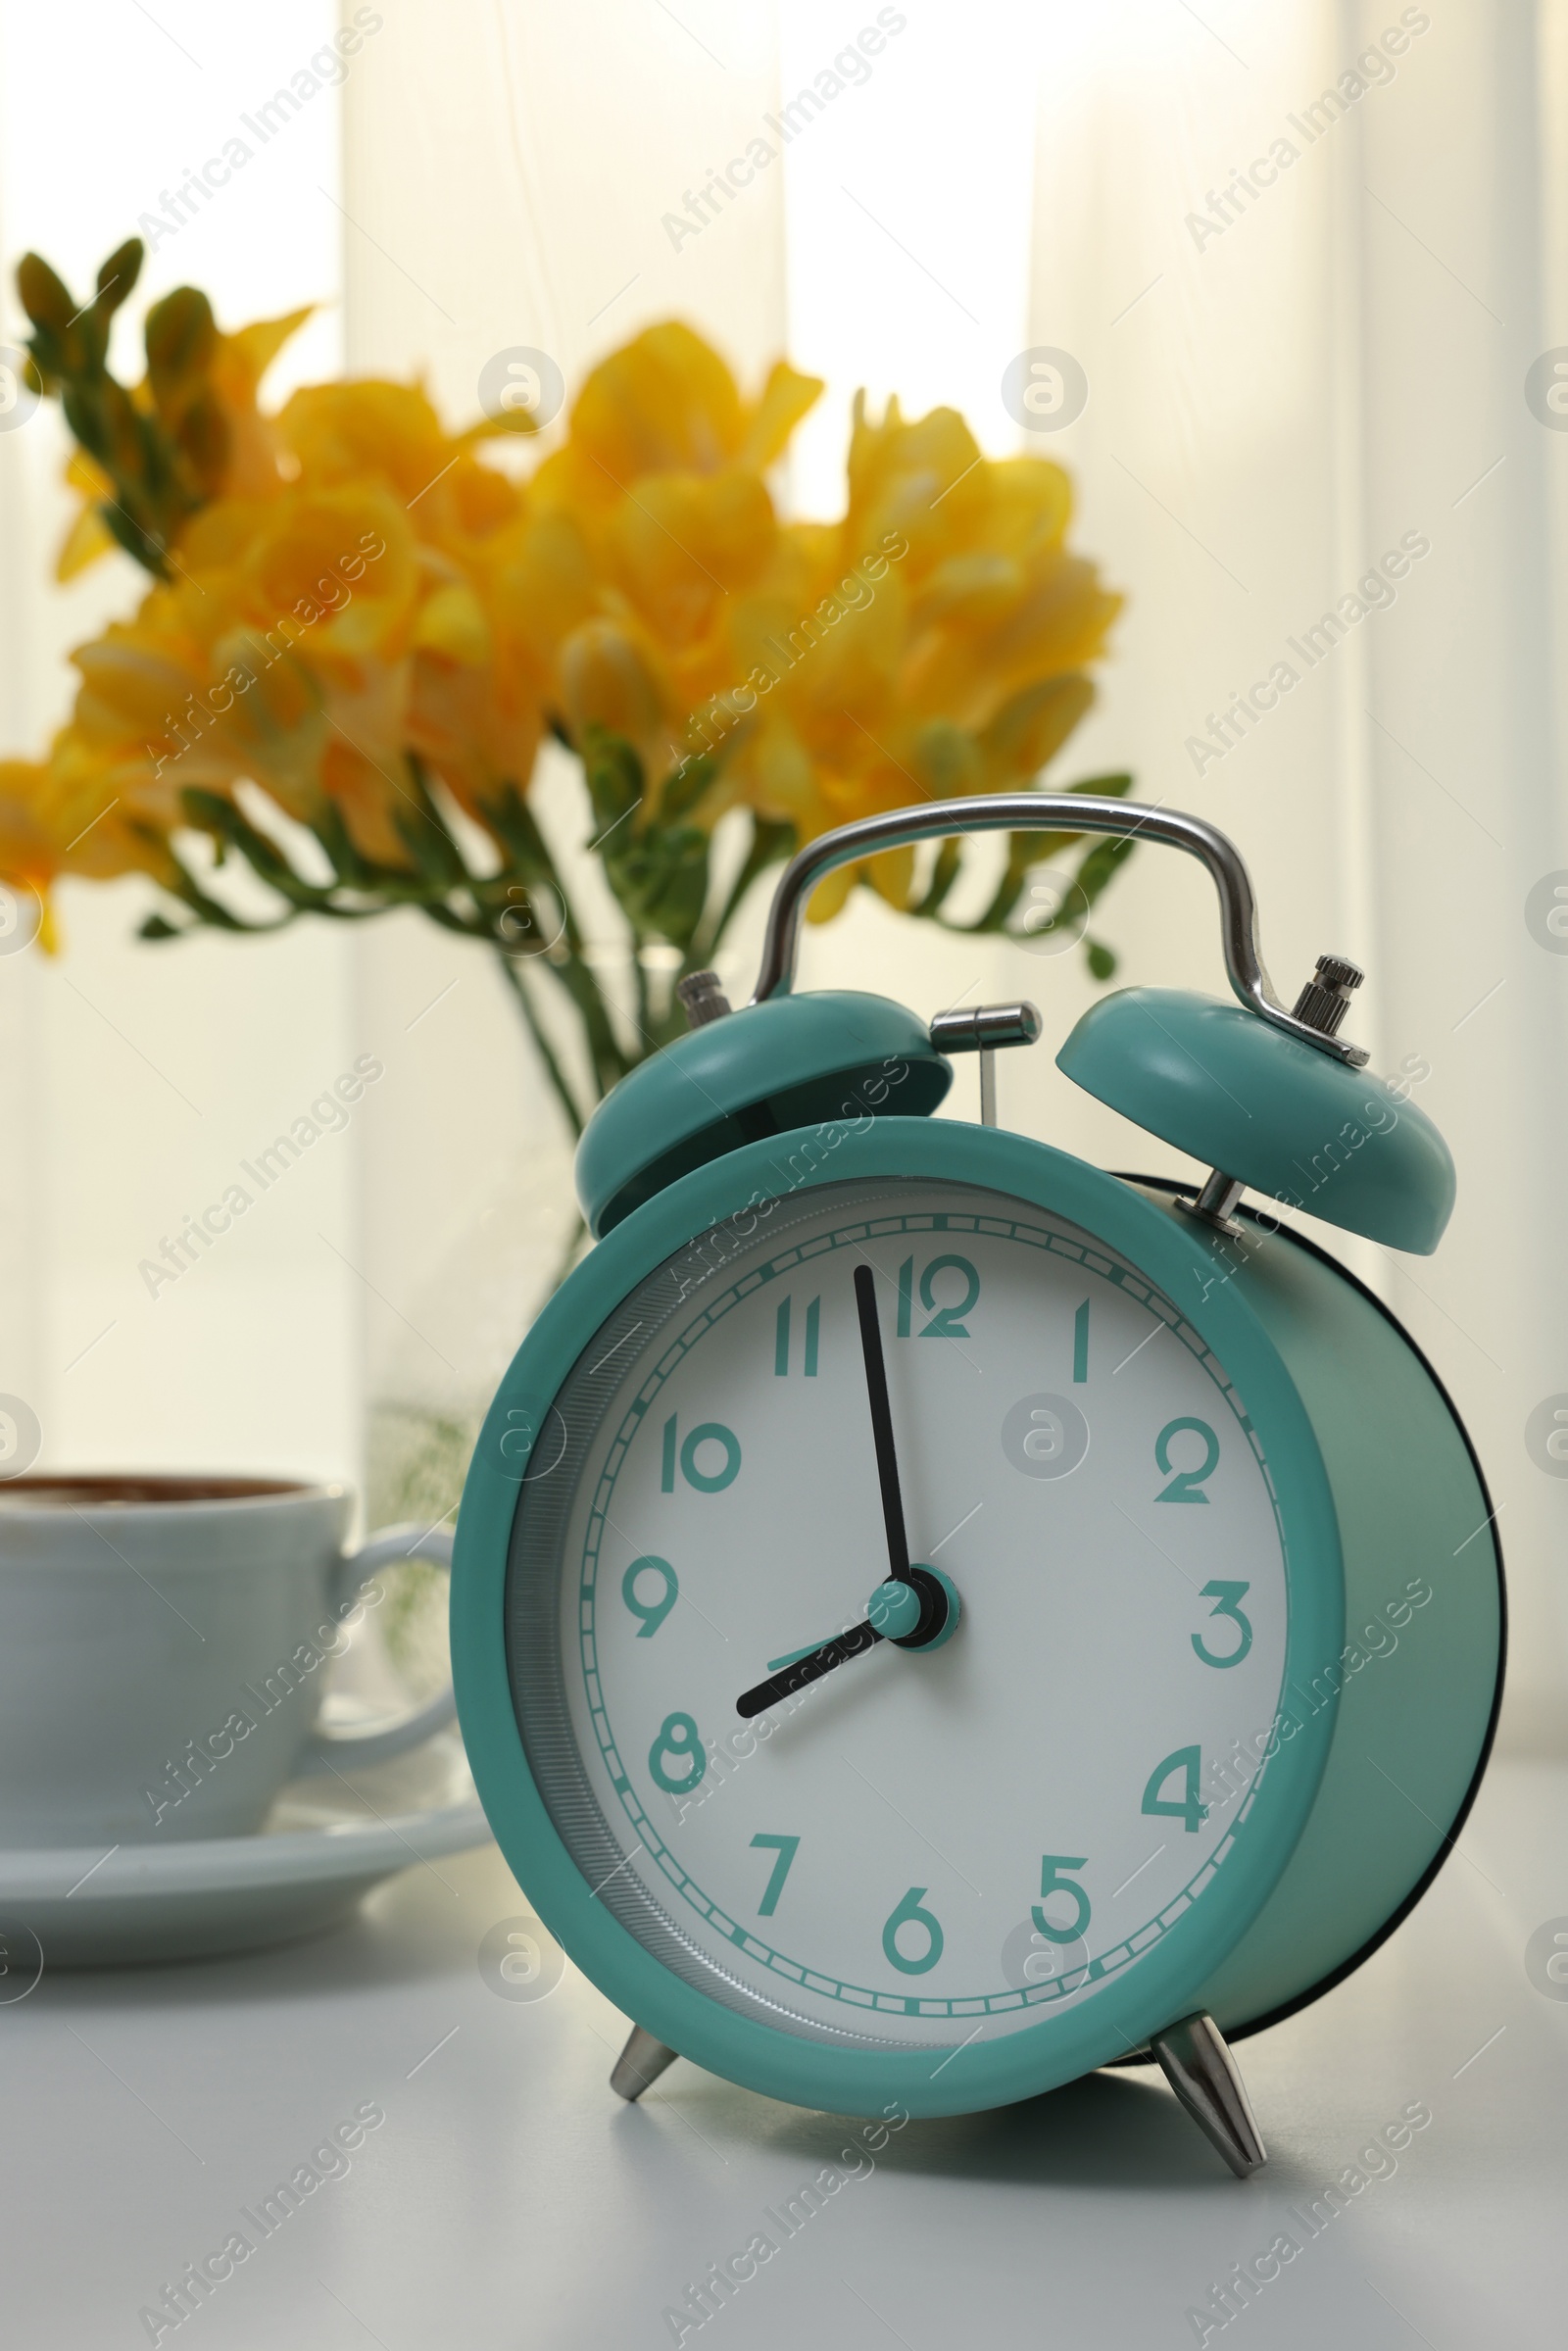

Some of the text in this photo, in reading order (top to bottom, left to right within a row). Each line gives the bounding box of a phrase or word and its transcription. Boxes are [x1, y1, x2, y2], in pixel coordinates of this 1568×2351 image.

[774, 1294, 819, 1376] 11
[898, 1255, 979, 1337] 12
[1073, 1298, 1090, 1383] 1
[662, 1412, 741, 1493] 10
[1153, 1417, 1219, 1503] 2
[622, 1556, 678, 1638] 9
[1192, 1581, 1251, 1668] 3
[649, 1713, 706, 1794] 8
[1142, 1745, 1207, 1832] 4
[751, 1835, 800, 1915] 7
[1032, 1856, 1091, 1943] 5
[883, 1887, 943, 1975] 6
